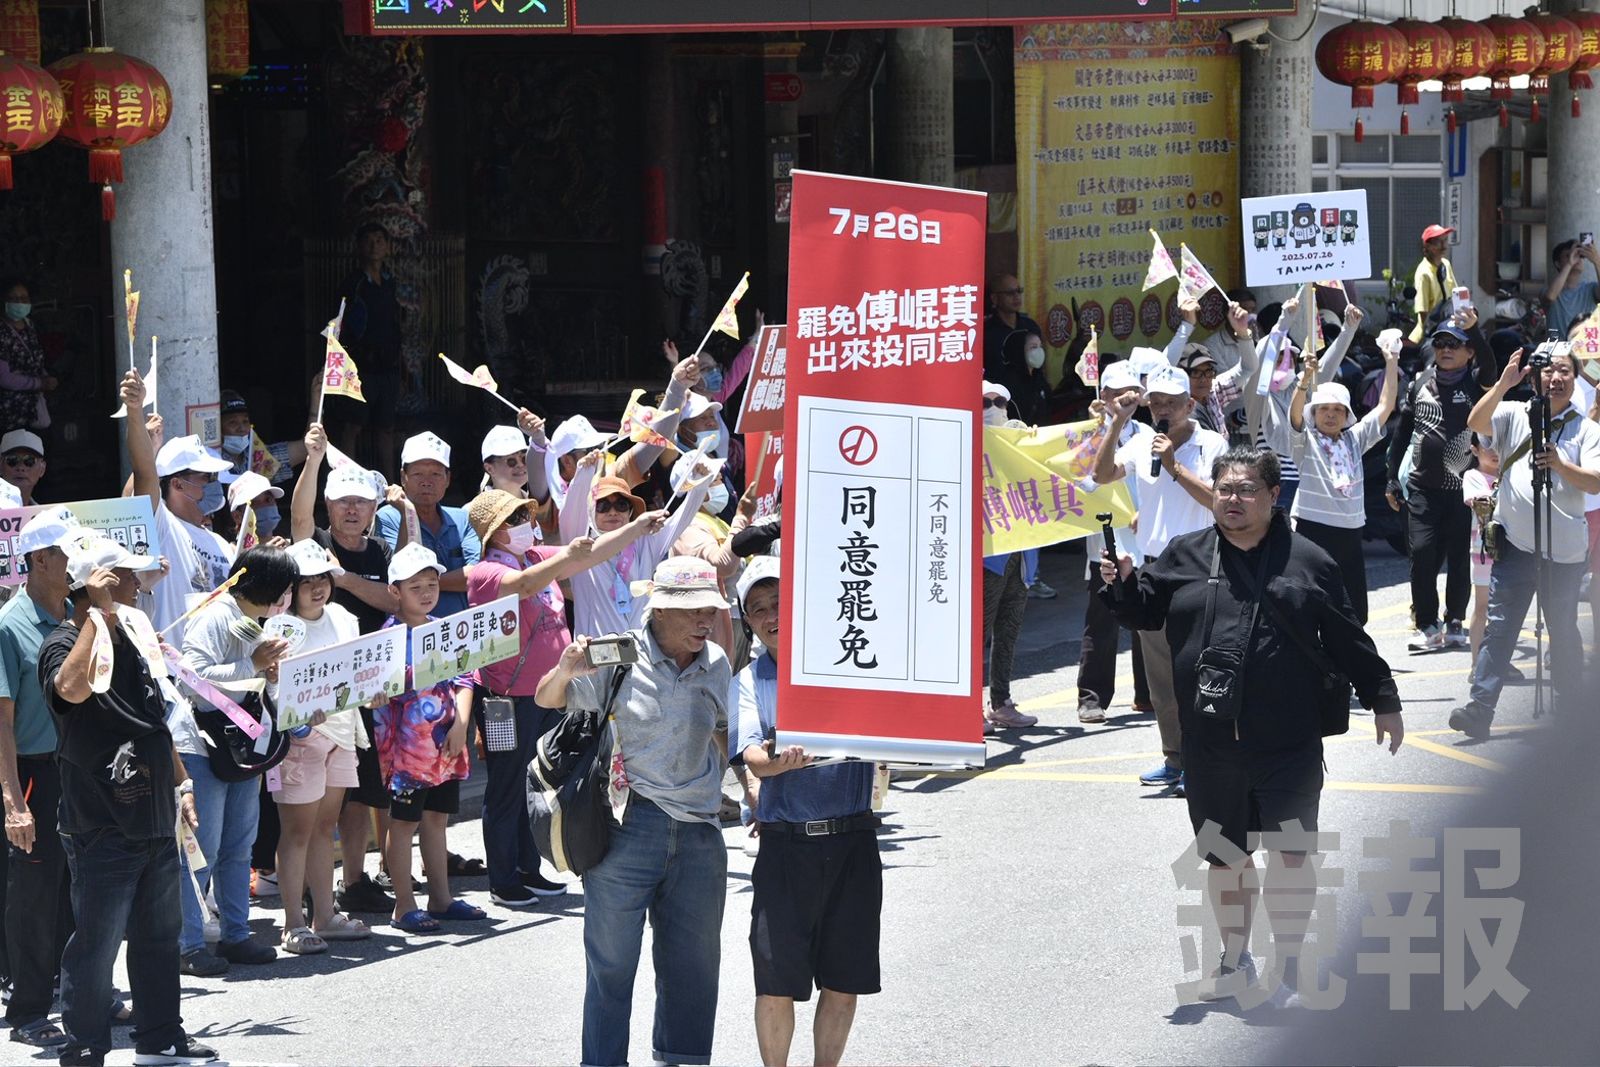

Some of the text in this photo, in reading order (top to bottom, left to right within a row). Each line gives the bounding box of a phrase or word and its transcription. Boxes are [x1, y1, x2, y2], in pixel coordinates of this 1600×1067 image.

[1364, 40, 1384, 71] 財源
[1415, 38, 1433, 69] 財源
[1456, 37, 1473, 68] 財源
[1510, 34, 1530, 63] 金玉
[1549, 34, 1567, 62] 財源
[4, 85, 35, 132] 金玉
[115, 82, 144, 129] 金玉
[829, 207, 941, 245] 7月26日
[1277, 263, 1334, 275] TAIWAN
[1281, 252, 1333, 262] 2025.07.26
[807, 328, 977, 375] 出來投同意!
[326, 352, 344, 386] 保台
[927, 493, 949, 604] 不同意罷免
[833, 486, 879, 669] 同意罷免
[422, 621, 453, 655] 同意
[472, 611, 498, 641] 罷免
[293, 661, 343, 686] 守護後代
[296, 682, 331, 704] 07.26
